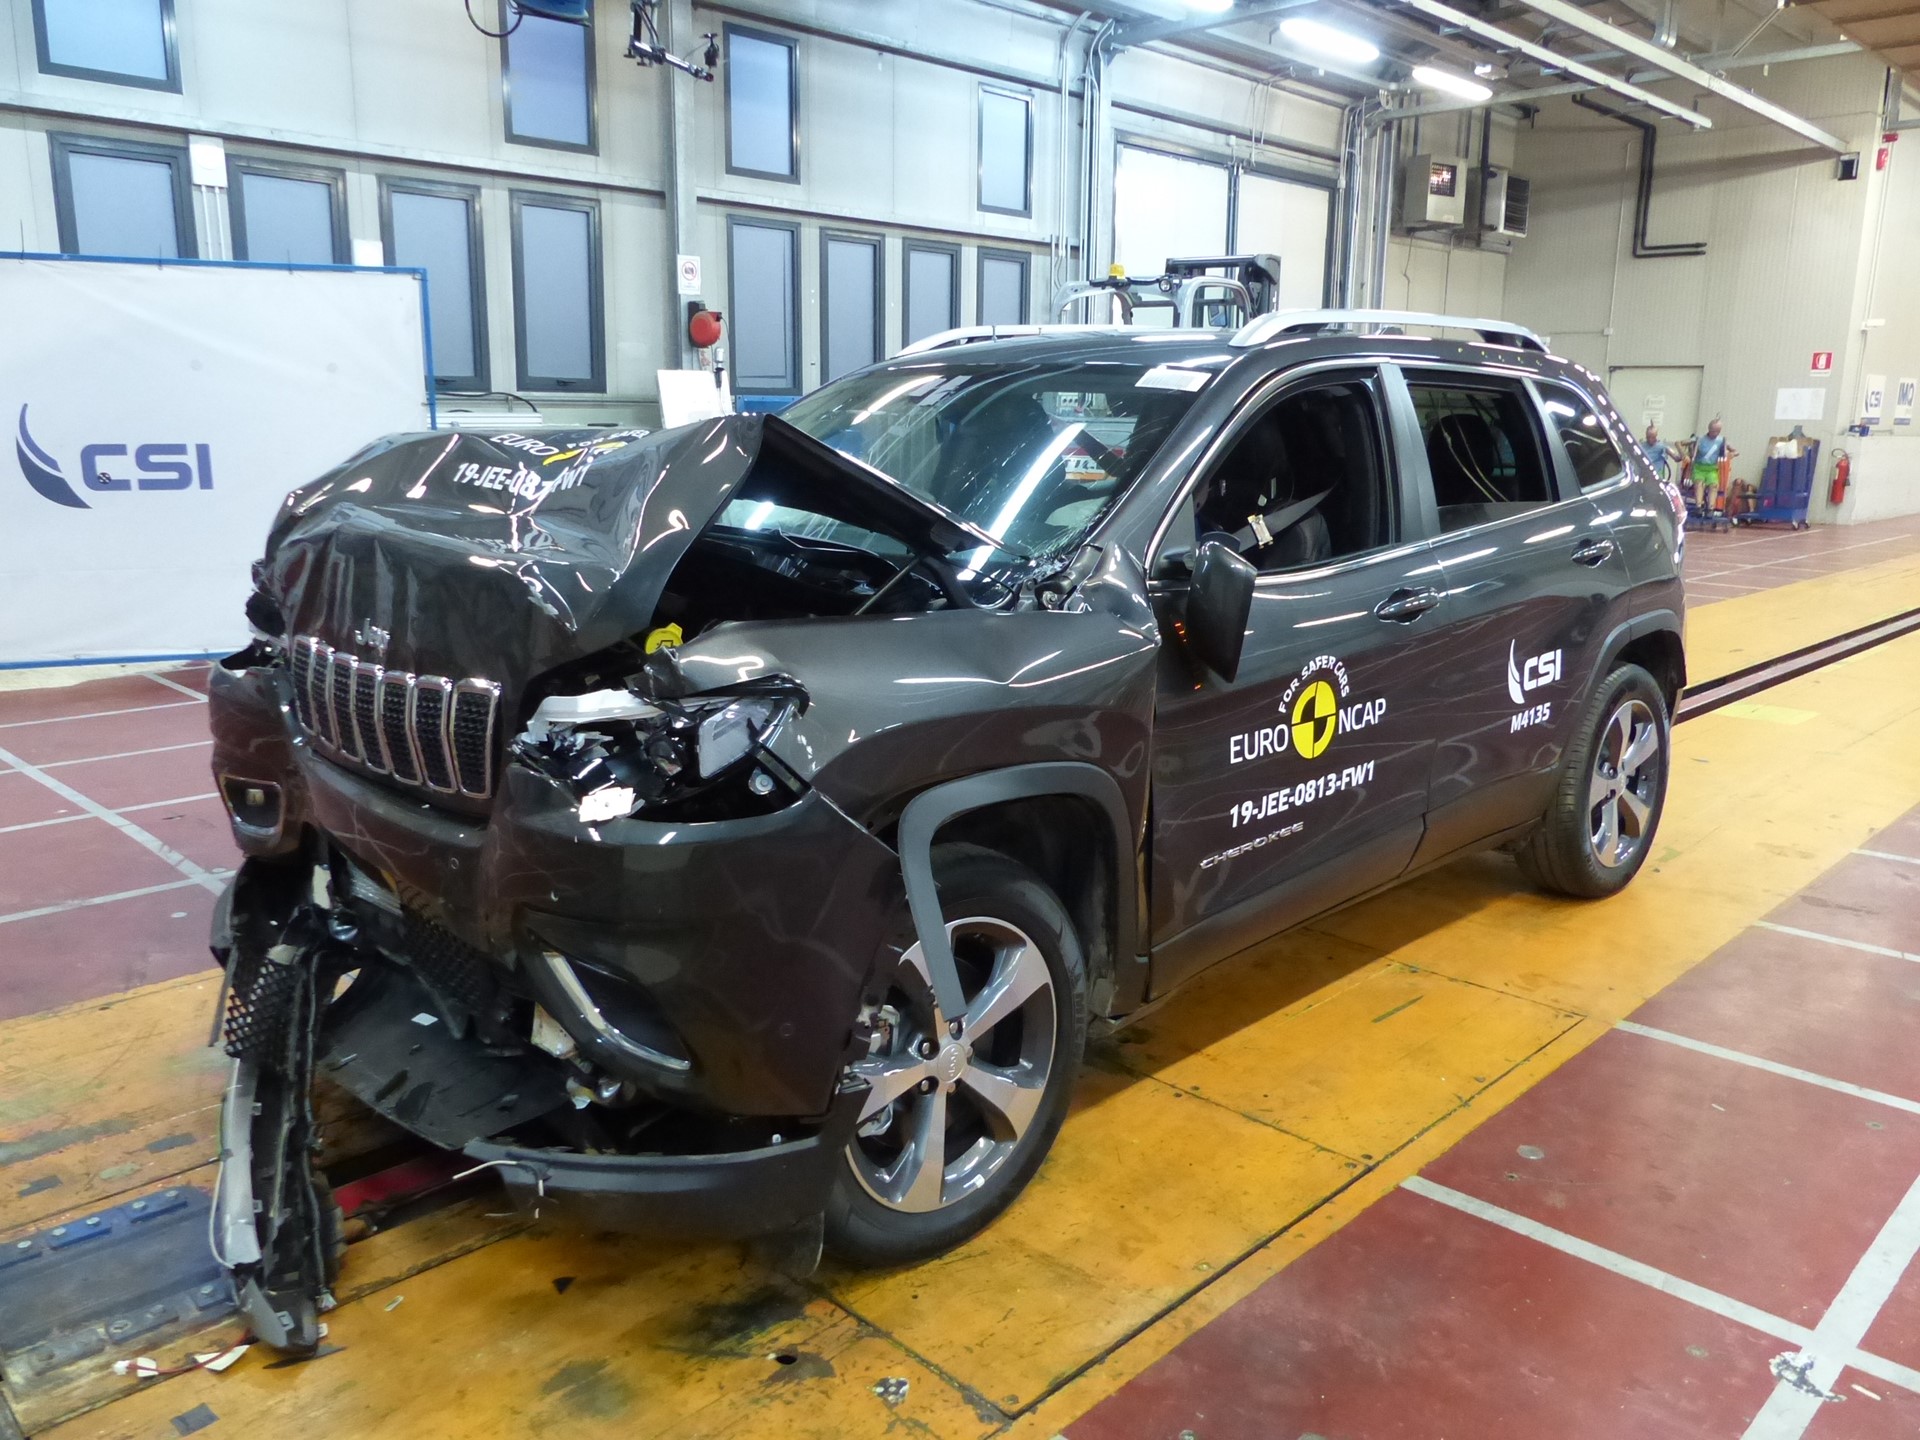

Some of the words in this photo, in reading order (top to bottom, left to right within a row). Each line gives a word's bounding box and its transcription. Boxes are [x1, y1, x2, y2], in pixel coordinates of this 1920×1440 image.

[1869, 390, 1882, 408] CSI
[80, 442, 214, 491] CSI
[489, 433, 560, 456] EURO
[1278, 677, 1300, 714] FOR
[1301, 655, 1337, 681] SAFER
[1333, 660, 1350, 698] CARS
[1523, 648, 1562, 692] CSI
[1230, 723, 1289, 765] EURO
[1338, 697, 1387, 735] NCAP
[1510, 701, 1552, 734] M4135
[1229, 759, 1376, 829] 19-JEE-0813-FW1
[1199, 821, 1304, 869] CHEROKEE
